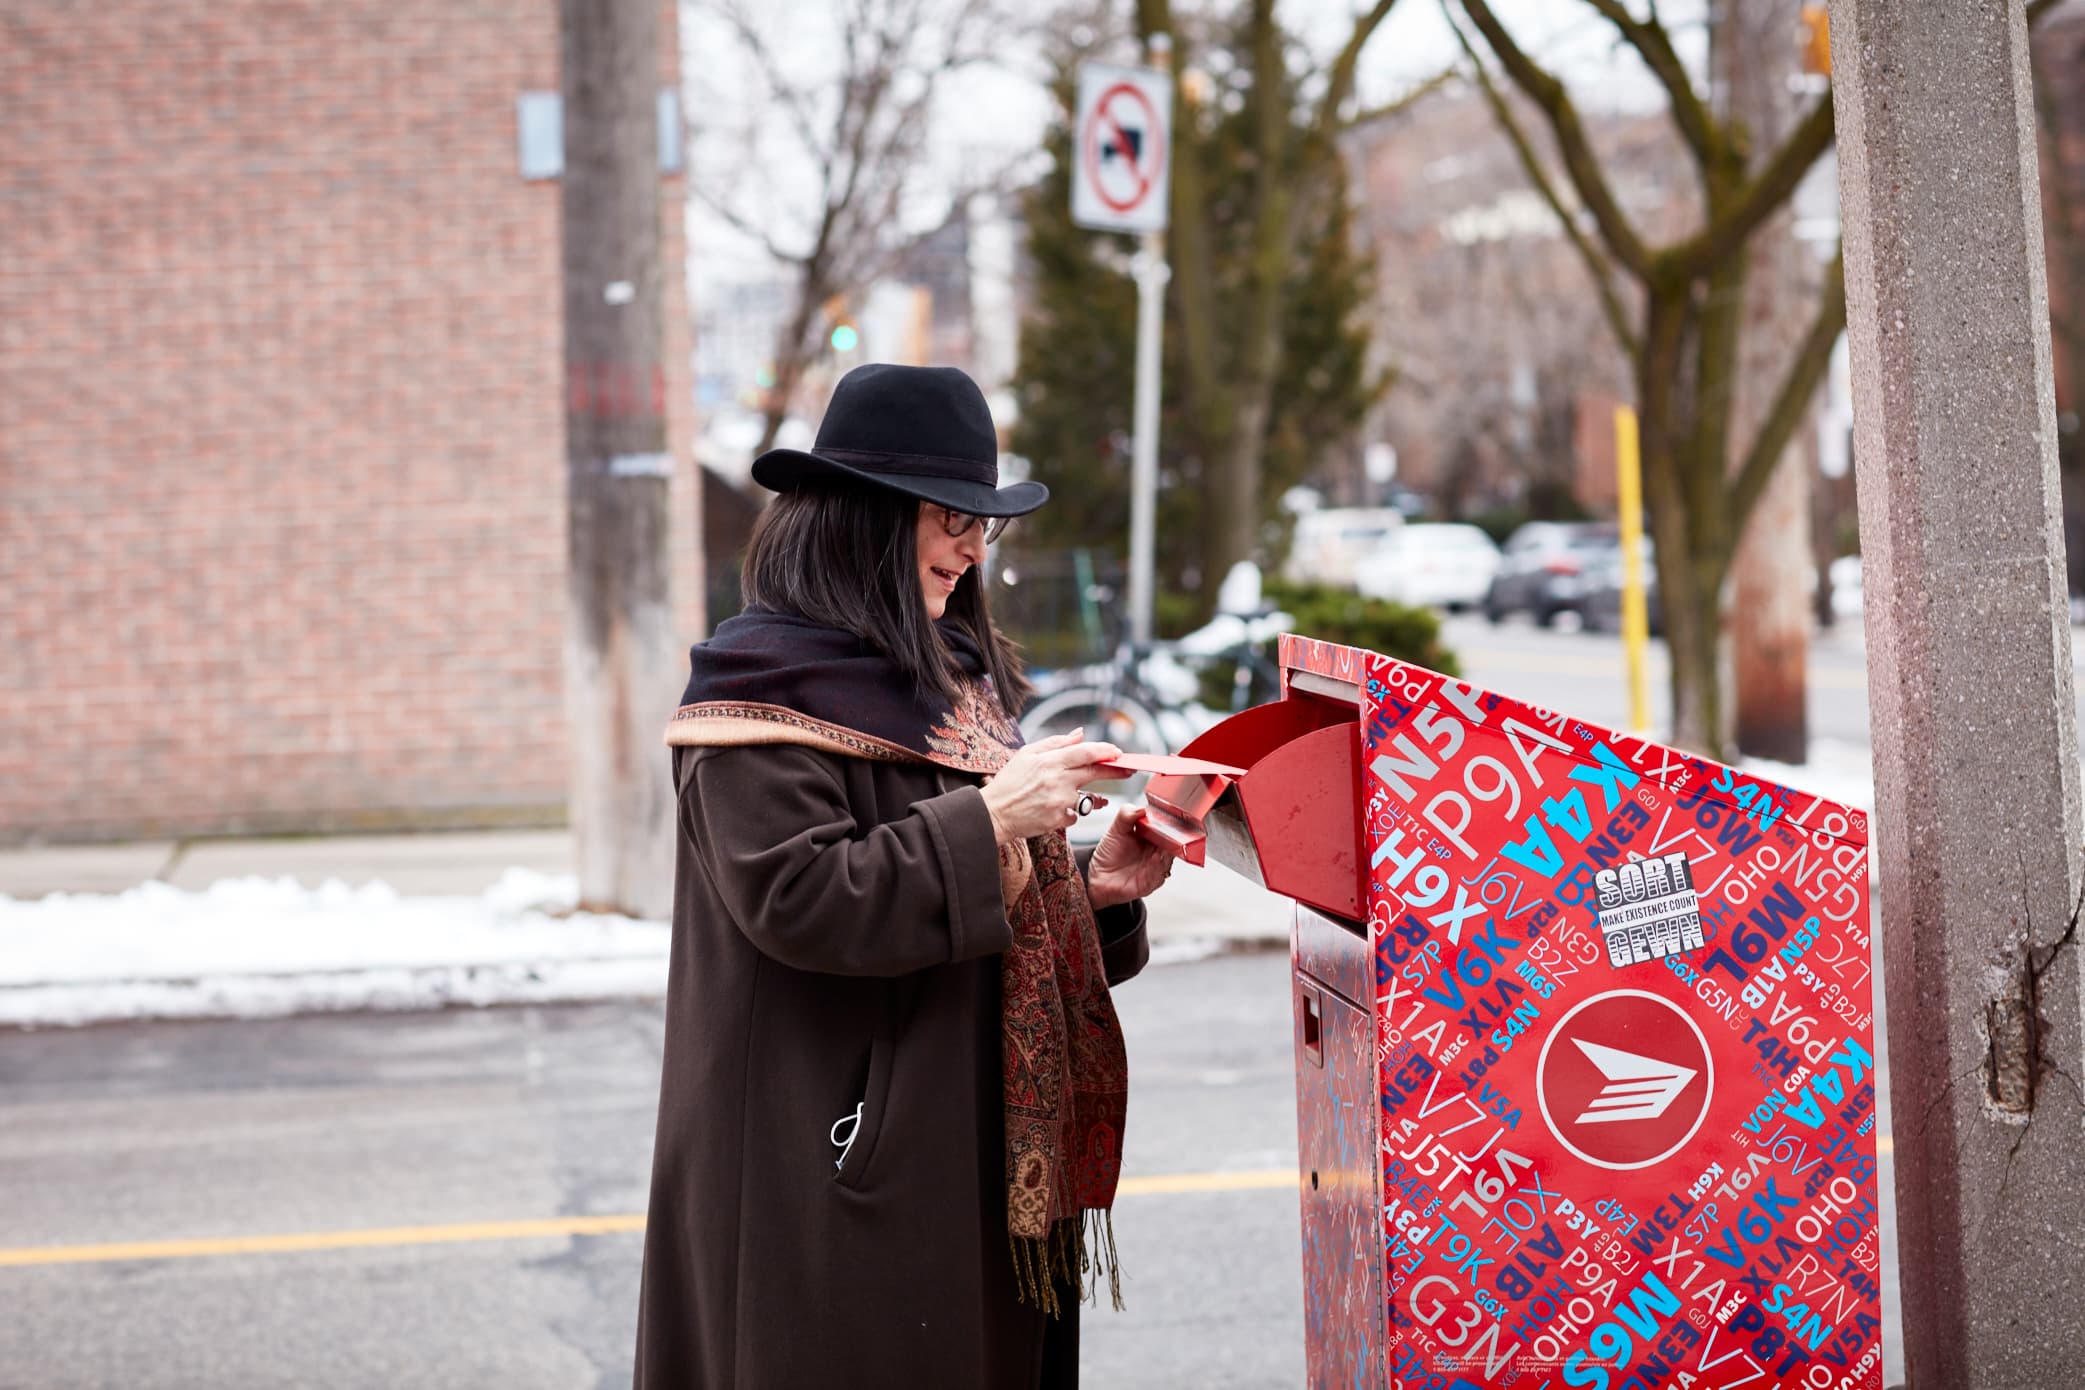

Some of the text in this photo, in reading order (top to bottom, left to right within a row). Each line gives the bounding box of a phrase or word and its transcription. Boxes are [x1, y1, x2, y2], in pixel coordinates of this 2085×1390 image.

[1367, 674, 1391, 703] 6X
[1573, 723, 1595, 742] E4P
[1422, 717, 1575, 861] P9A
[1668, 769, 1693, 795] M3C
[1711, 768, 1784, 833] S4N
[1402, 814, 1430, 841] T1C
[1498, 740, 1640, 878] K4A
[1585, 800, 1651, 868] E3N
[1676, 784, 1762, 858] J6W
[1426, 837, 1453, 861] E4P
[1785, 797, 1868, 878] P8T
[1371, 826, 1488, 948] H9X
[1460, 857, 1543, 920] J6V
[1595, 851, 1687, 908] SORT
[1779, 842, 1859, 922] G5N
[1526, 901, 1558, 939] R2P
[1602, 895, 1697, 928] MAKE EXISTENCE COUNT
[1702, 881, 1807, 982] M9L
[1845, 920, 1869, 950] Y1A
[1403, 940, 1442, 989] S7P
[1422, 916, 1522, 1011] V6K
[1528, 937, 1579, 987] B2Z
[1550, 916, 1599, 965] G3N
[1779, 916, 1821, 966] N5P
[1514, 959, 1557, 999] M6S
[1664, 953, 1700, 987] G6X
[1741, 955, 1788, 1009] A1B
[1793, 962, 1827, 993] P3Y
[1376, 975, 1447, 1058] X1A
[1458, 977, 1524, 1039] V1X
[1491, 999, 1541, 1052] S4N
[1696, 977, 1740, 1021] G5N
[1832, 995, 1864, 1026] B2J
[1438, 1033, 1469, 1066] M3C
[1742, 1017, 1801, 1078] T4H
[1769, 990, 1837, 1065] P9A
[1381, 1052, 1435, 1115] E3N
[1460, 1046, 1500, 1091] P8T
[1782, 1036, 1873, 1129] K4A
[1418, 1069, 1505, 1162] V7J
[1479, 1081, 1523, 1131] V5A
[1382, 1117, 1419, 1156] Y1A
[1399, 1133, 1473, 1192] J5T
[1756, 1123, 1823, 1175] J6V
[1817, 1122, 1876, 1184] B4E
[1383, 1159, 1433, 1210] B4E
[1449, 1149, 1535, 1218] V9L
[1687, 1161, 1725, 1202] K6H
[1713, 1152, 1773, 1201] V9L
[1803, 1161, 1836, 1198] R2P
[1384, 1199, 1431, 1246] P3Y
[1553, 1198, 1601, 1240] P3Y
[1595, 1198, 1639, 1238] E4P
[1630, 1193, 1695, 1258] T3M
[1684, 1202, 1720, 1246] S7P
[1704, 1176, 1801, 1270] V6K
[1426, 1213, 1495, 1287] T9K
[1495, 1222, 1565, 1302] A1B
[1602, 1240, 1640, 1276] B2J
[1652, 1235, 1727, 1317] X1A
[1740, 1235, 1803, 1298] V1X
[1851, 1241, 1878, 1272] B2J
[1561, 1246, 1617, 1308] P9A
[1787, 1253, 1860, 1325] R7N
[1838, 1257, 1879, 1303] T4H
[1409, 1275, 1522, 1382] G3N
[1474, 1288, 1510, 1323] G6X
[1563, 1269, 1683, 1390] M6S
[1715, 1289, 1748, 1325] M3C
[1761, 1282, 1834, 1352] S4N
[1410, 1326, 1437, 1354] T1C
[1636, 1318, 1703, 1388] E3N
[1727, 1303, 1811, 1379] P8T
[1821, 1311, 1879, 1366] V5A
